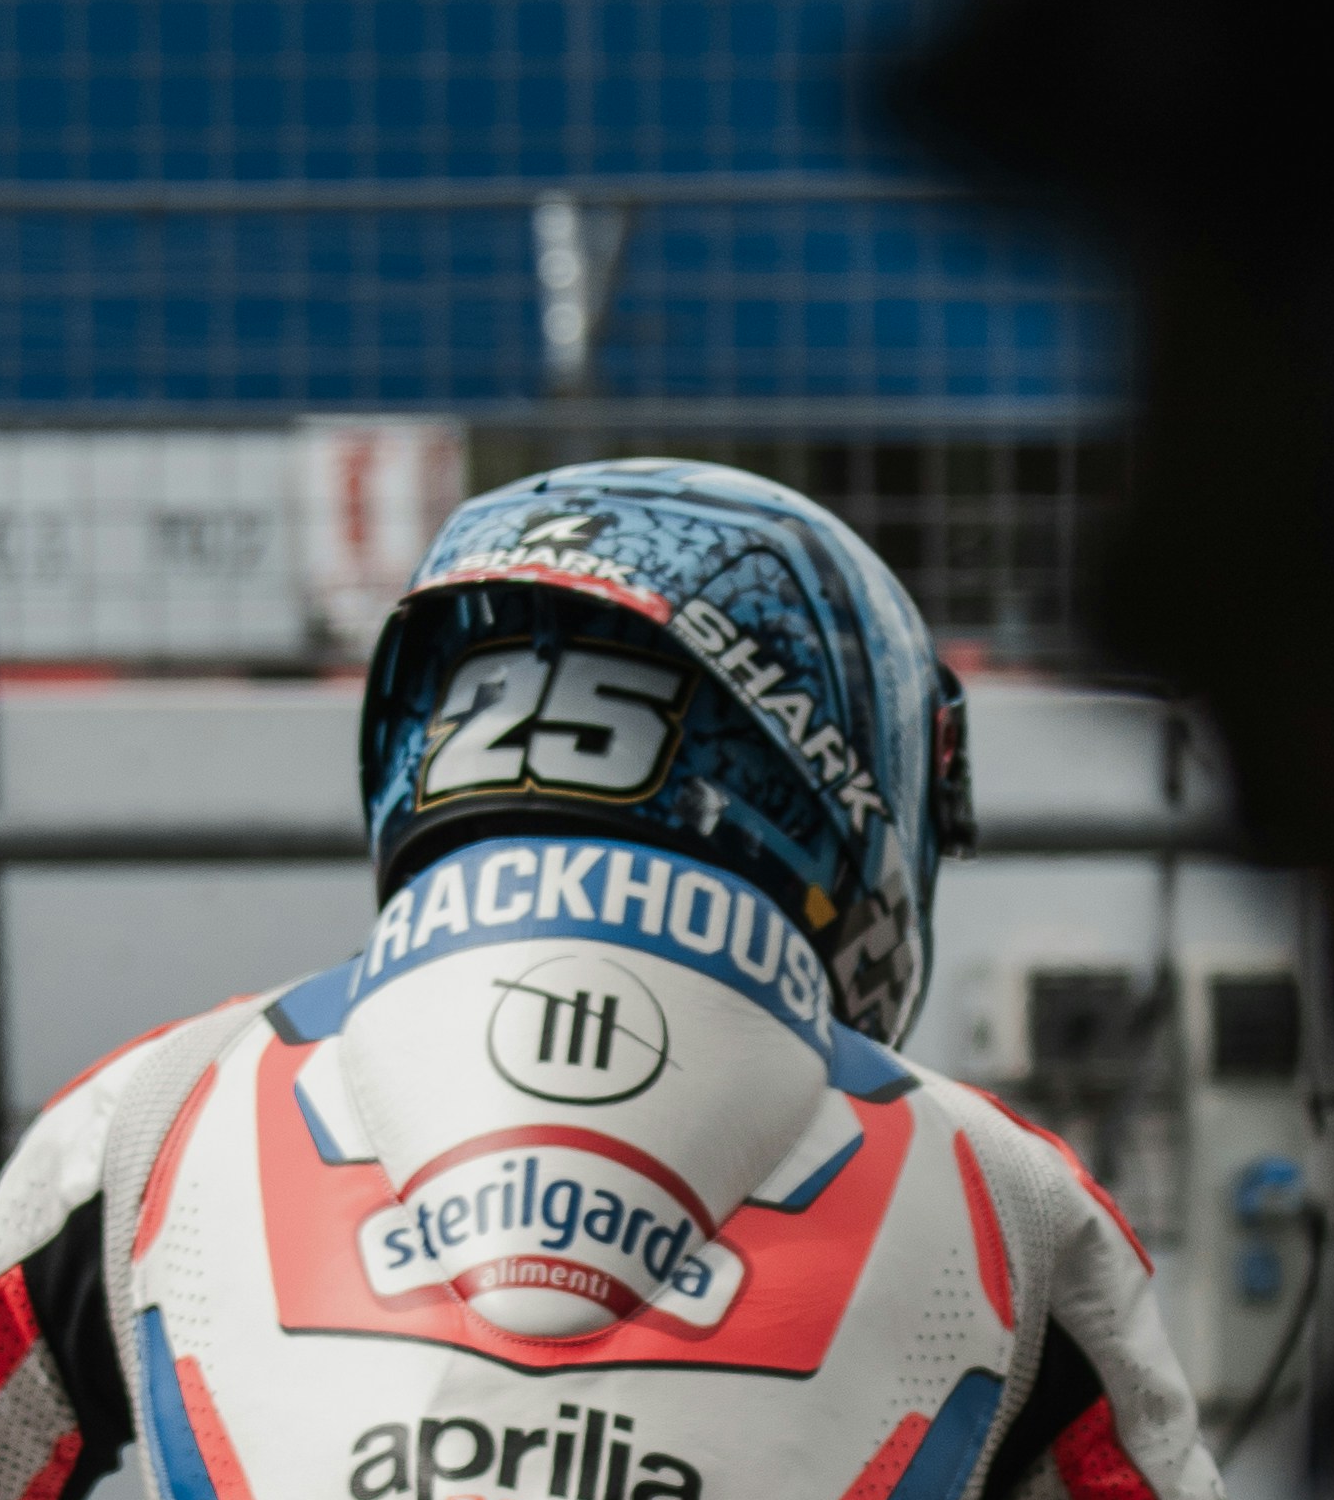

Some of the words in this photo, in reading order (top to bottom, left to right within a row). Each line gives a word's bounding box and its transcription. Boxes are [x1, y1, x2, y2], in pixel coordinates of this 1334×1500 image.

[455, 546, 636, 588] SHARK
[425, 642, 685, 798] 25
[670, 598, 889, 834] SHARK
[383, 1157, 712, 1300] sterilgarda
[479, 1256, 613, 1300] alimenti
